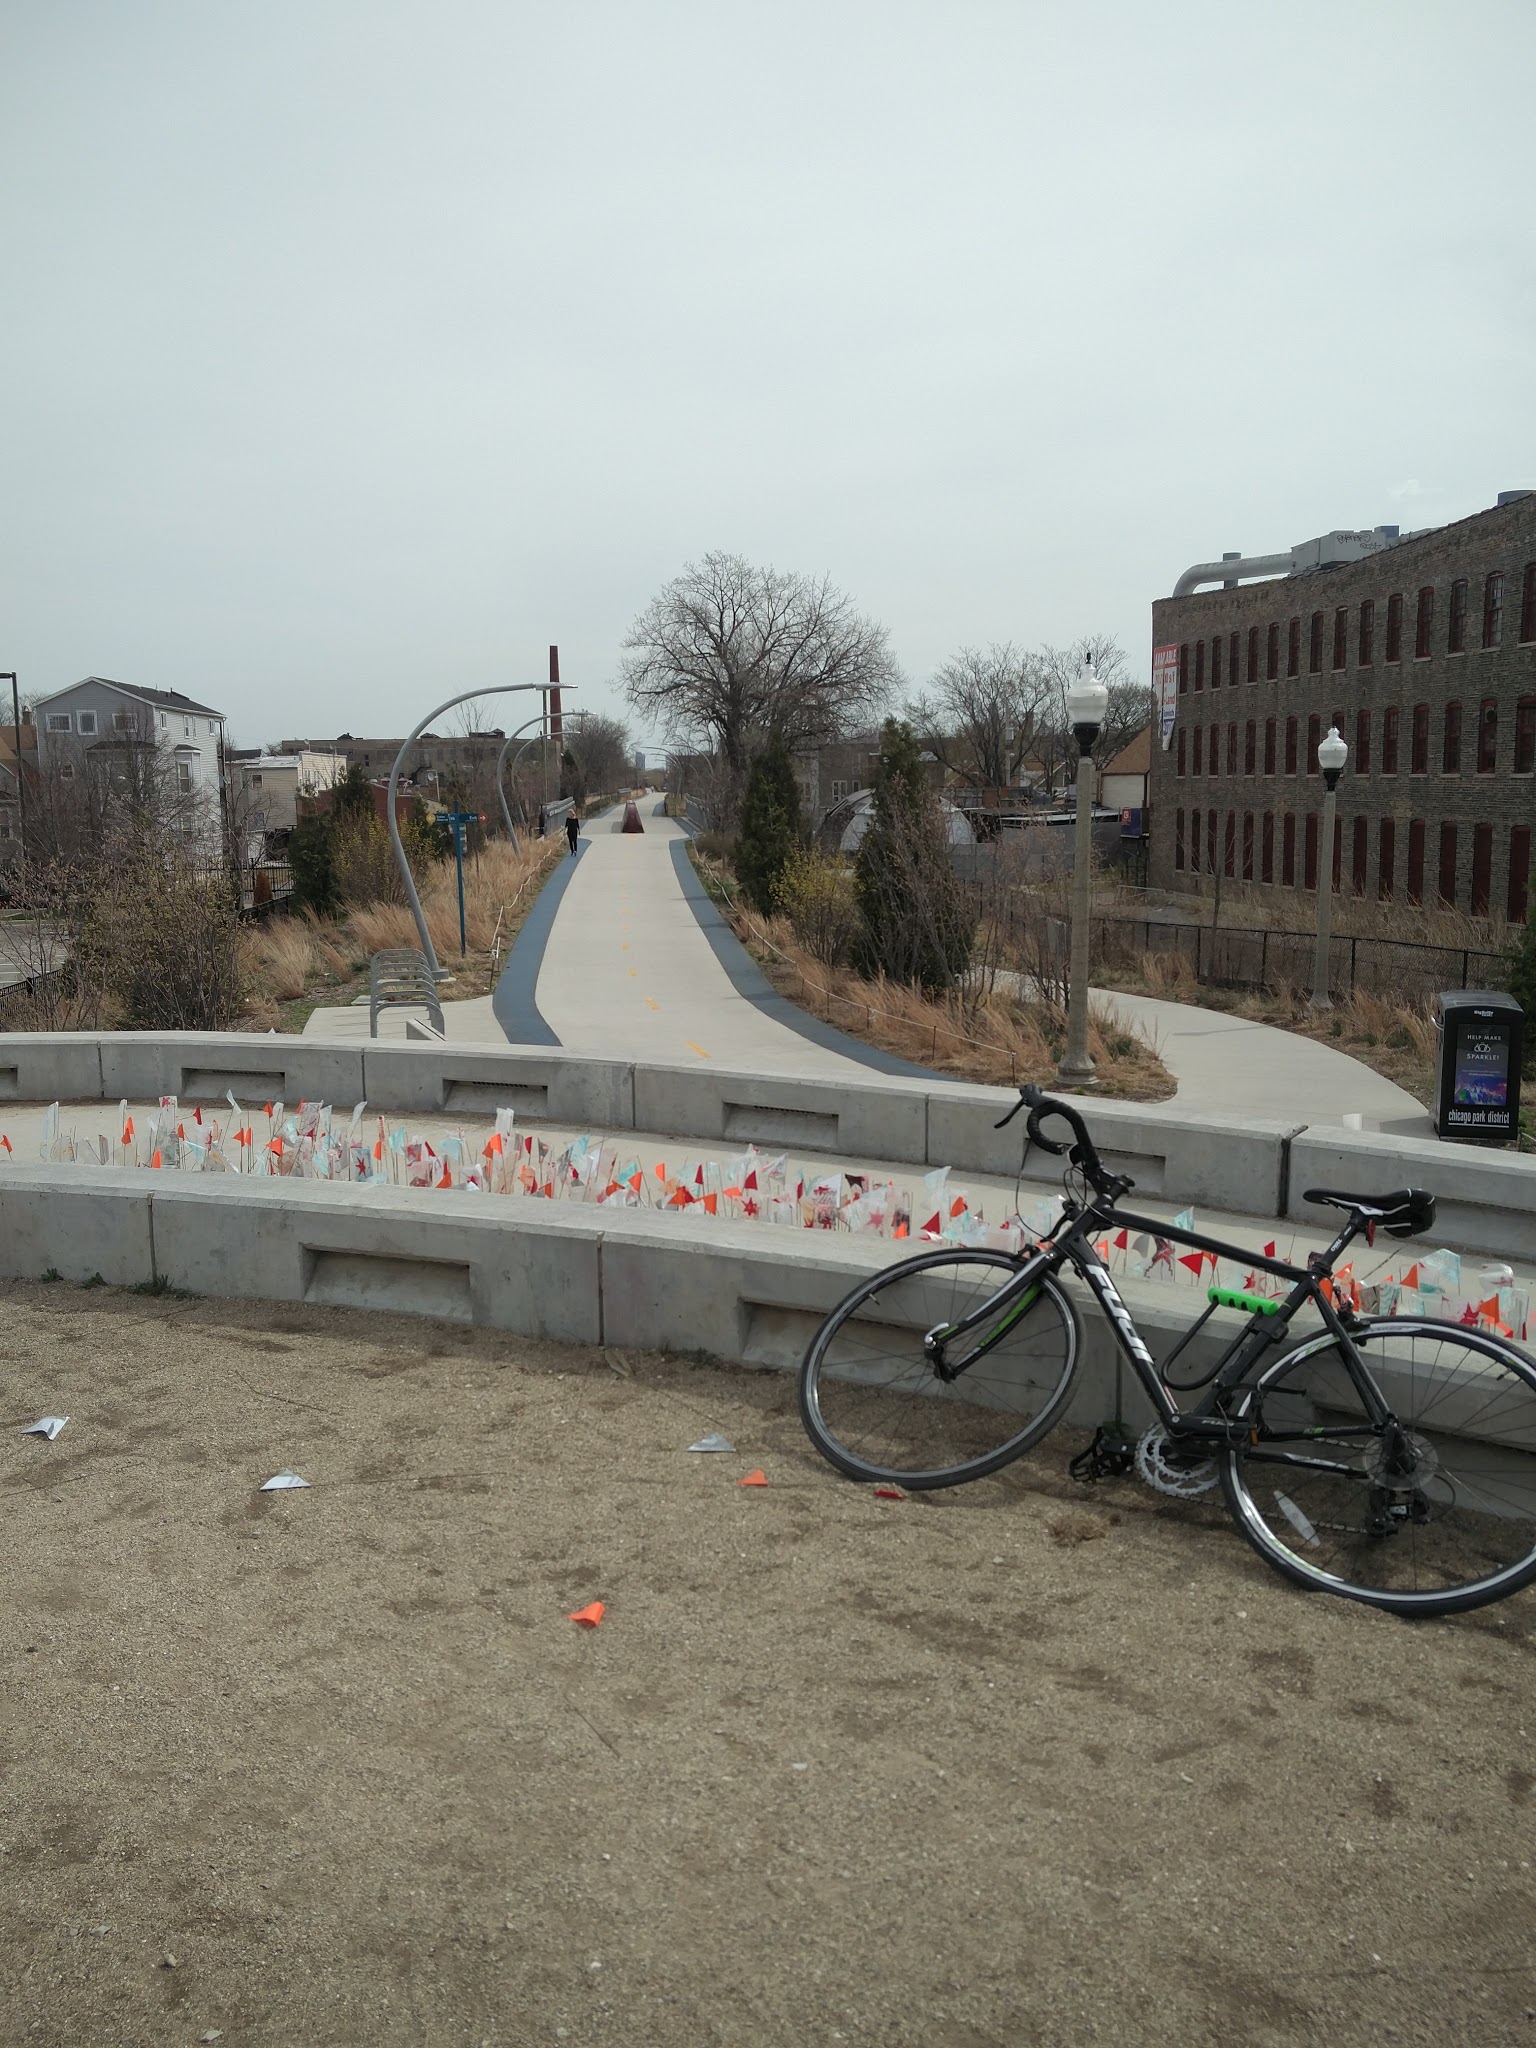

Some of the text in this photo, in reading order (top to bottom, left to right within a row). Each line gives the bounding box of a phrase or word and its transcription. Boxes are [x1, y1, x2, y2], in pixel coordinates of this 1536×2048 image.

[1155, 649, 1176, 666] AVAIABLE
[1466, 1053, 1500, 1061] SPARKLE!
[1448, 1109, 1510, 1124] chicago park district
[1085, 1264, 1155, 1365] FUJI
